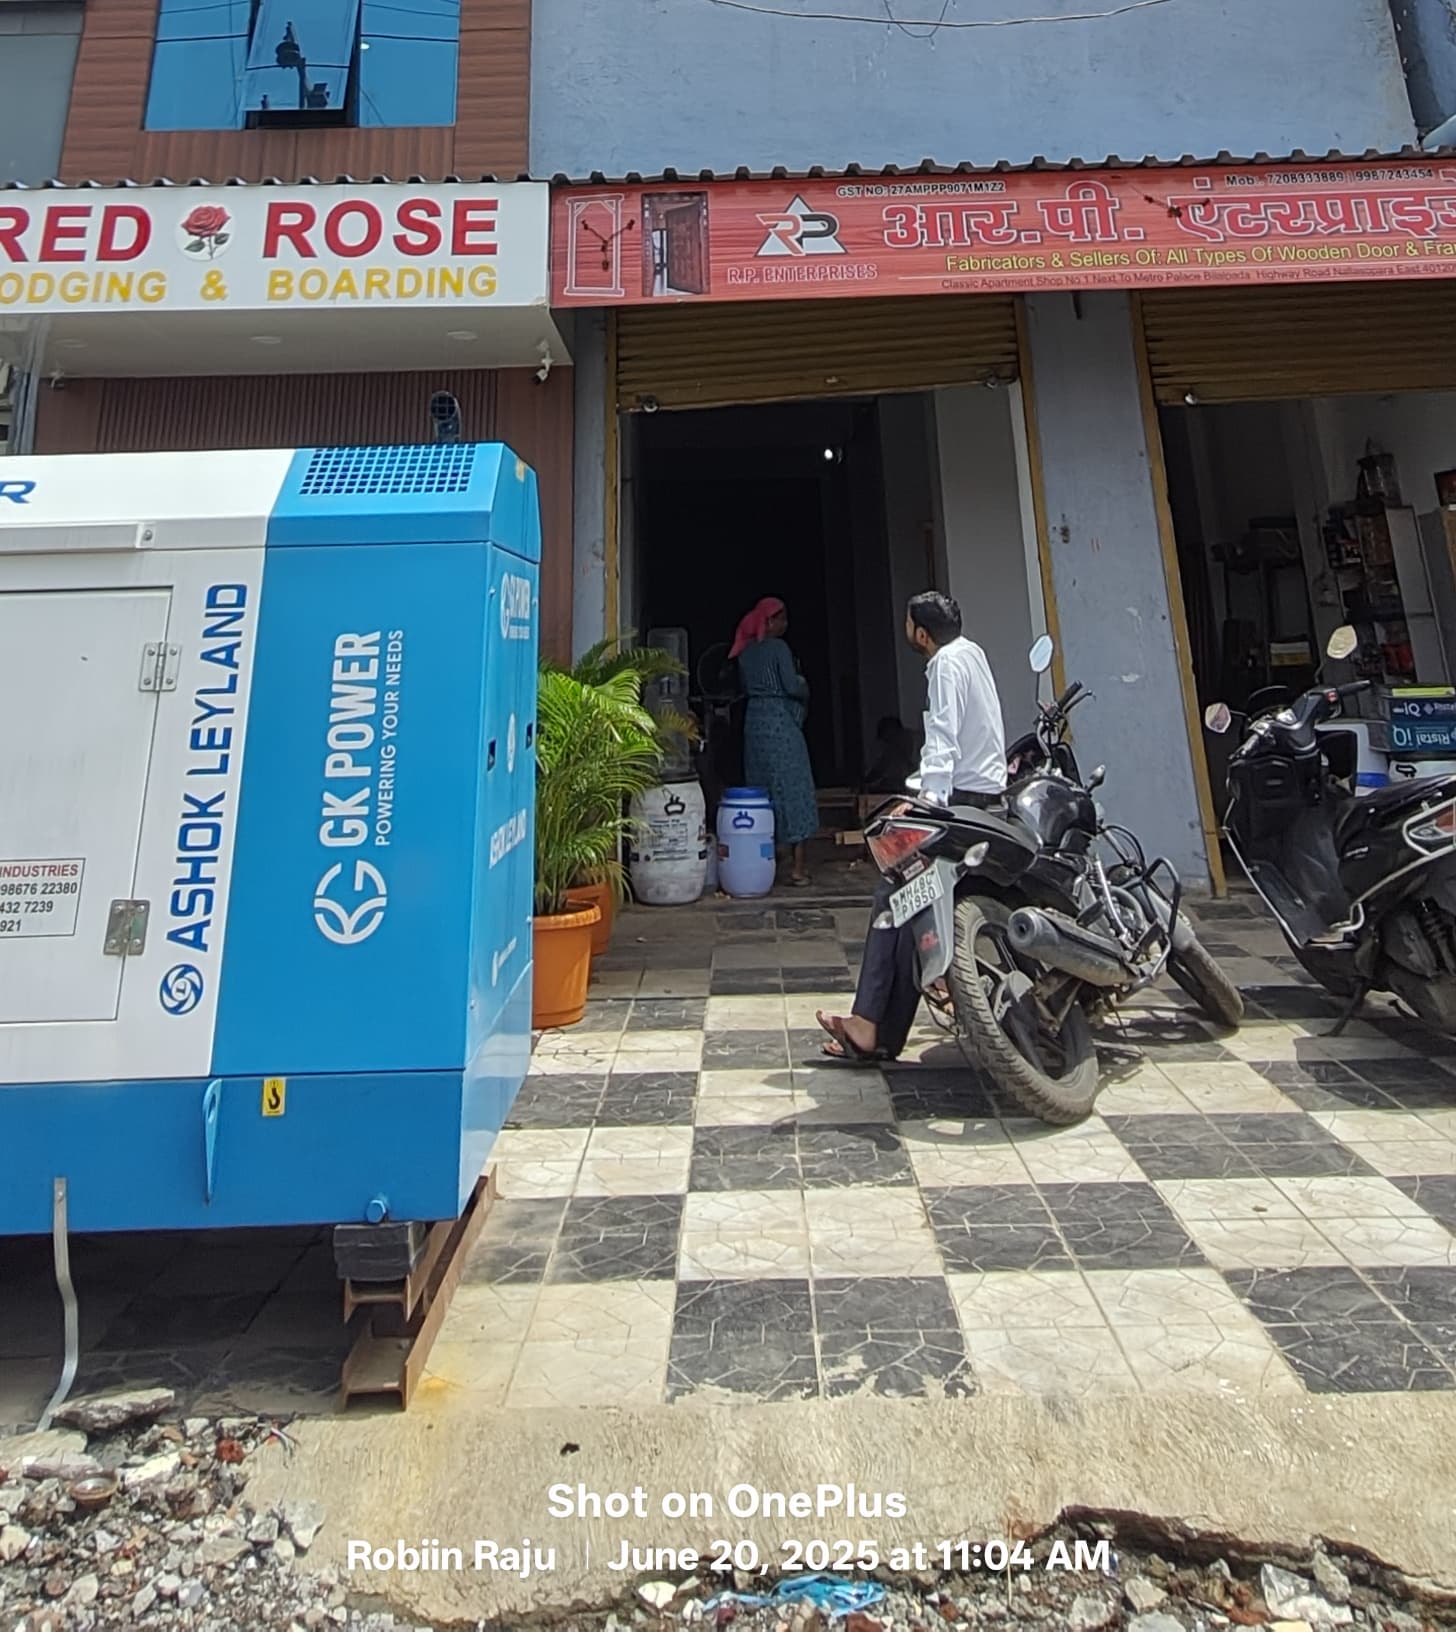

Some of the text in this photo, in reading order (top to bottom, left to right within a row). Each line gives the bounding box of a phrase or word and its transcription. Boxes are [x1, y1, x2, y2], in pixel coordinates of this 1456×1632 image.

[837, 185, 862, 198] GST
[864, 184, 888, 197] NO:
[0, 198, 499, 262] RED ROSE
[945, 254, 1046, 272] Fabricators
[1051, 253, 1065, 268] &
[1070, 251, 1130, 267] Sellers
[1166, 247, 1188, 264] All
[1193, 247, 1247, 267] Types
[1252, 246, 1274, 262] Of
[1277, 243, 1352, 261] Wooden
[1356, 241, 1400, 258] Door
[1405, 240, 1419, 256] &
[1424, 239, 1456, 256] Fra
[0, 264, 497, 305] ODGING & BOARDING
[727, 263, 879, 284] R.P. ENTERPRISES
[941, 278, 979, 289] Classic
[980, 276, 1034, 290] Apartment
[1036, 274, 1064, 288] Shop
[319, 630, 381, 848] GK POWER
[375, 628, 404, 847] POWERING YOUR NEEDS
[166, 583, 248, 953] ASHOK LEYLAND
[40, 881, 78, 895] 22380
[24, 900, 54, 914] 7239
